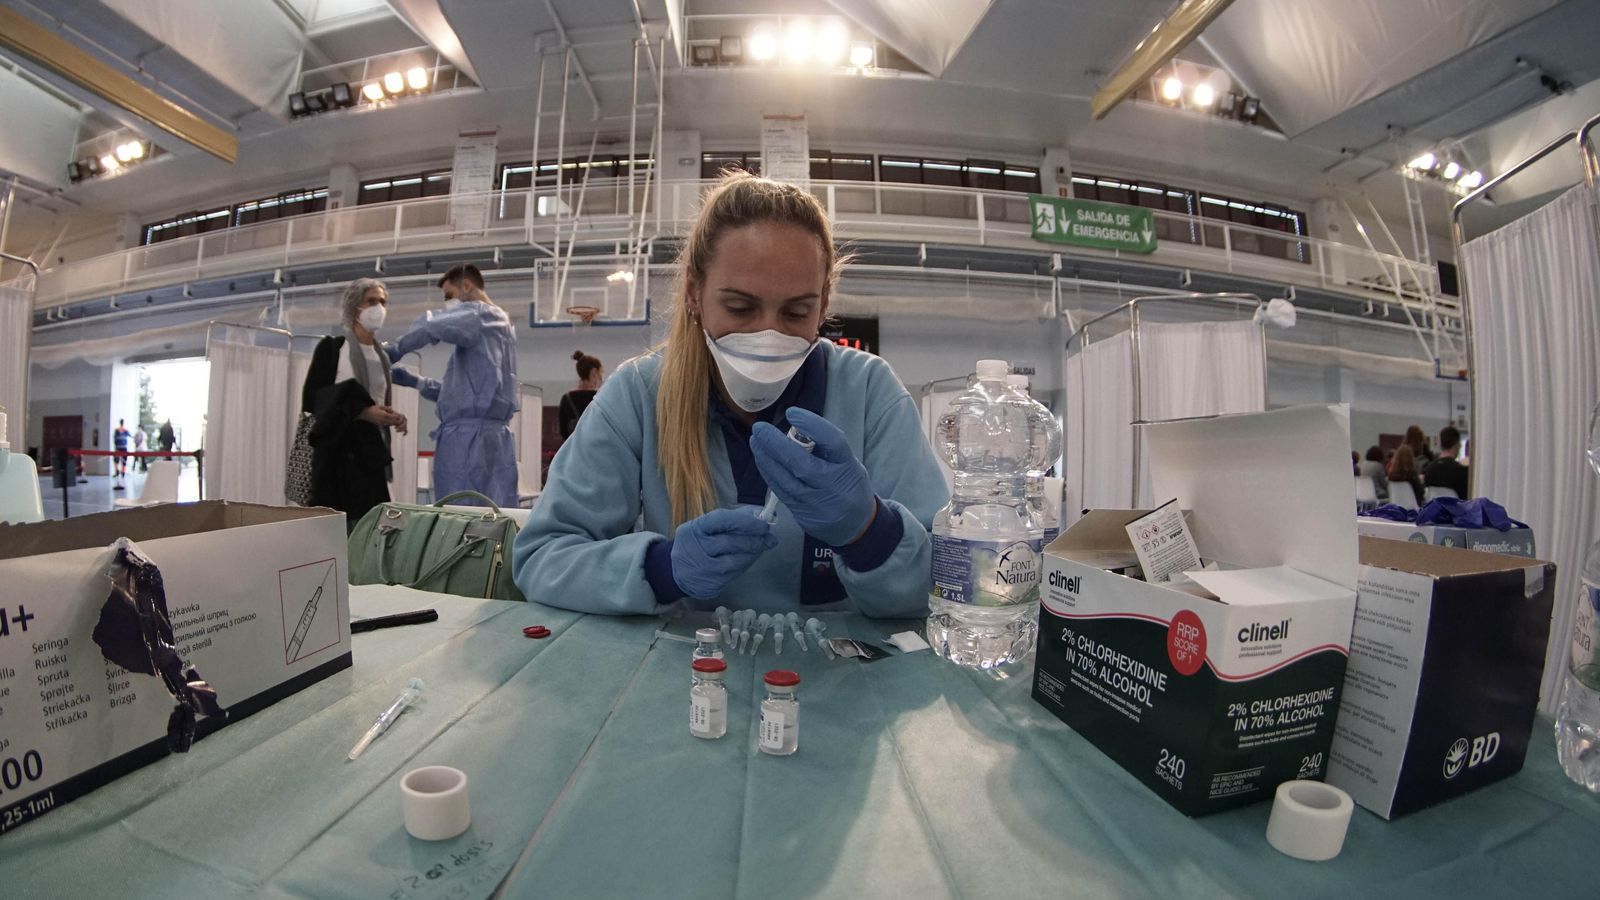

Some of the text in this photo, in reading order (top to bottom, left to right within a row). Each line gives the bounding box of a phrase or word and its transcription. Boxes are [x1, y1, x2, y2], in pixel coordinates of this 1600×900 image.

[1077, 209, 1130, 227] SALIDA DE
[1073, 224, 1140, 243] EMERGENCIA
[814, 548, 832, 559] UR
[1011, 560, 1032, 572] FONT
[996, 570, 1036, 585] Natura
[1048, 570, 1080, 594] clinell
[168, 603, 200, 619] zykawka
[1177, 622, 1199, 641] RRP
[1238, 620, 1289, 643] clinell
[32, 638, 69, 654] Seringa
[1174, 637, 1200, 656] SCORE
[35, 654, 67, 670] Ruisku
[1061, 627, 1075, 646] 2%
[1078, 635, 1168, 692] CHLORHEXIDINE
[1176, 650, 1193, 664] OF 1
[37, 670, 70, 686] Spruta
[1066, 647, 1153, 708] IN 70% ALCOHOL
[40, 683, 75, 702] Sprøjte
[110, 692, 137, 708] Brizga
[1227, 687, 1335, 717] 2% CHLORHEXIDINE
[43, 694, 91, 716] Striekačka
[1234, 718, 1247, 732] IN
[1251, 714, 1274, 729] 70%
[1276, 704, 1325, 724] ALCOHOL
[1468, 732, 1500, 768] BD
[1158, 748, 1186, 780] 240
[1300, 752, 1322, 772] 240
[1155, 766, 1183, 790] SACHETS
